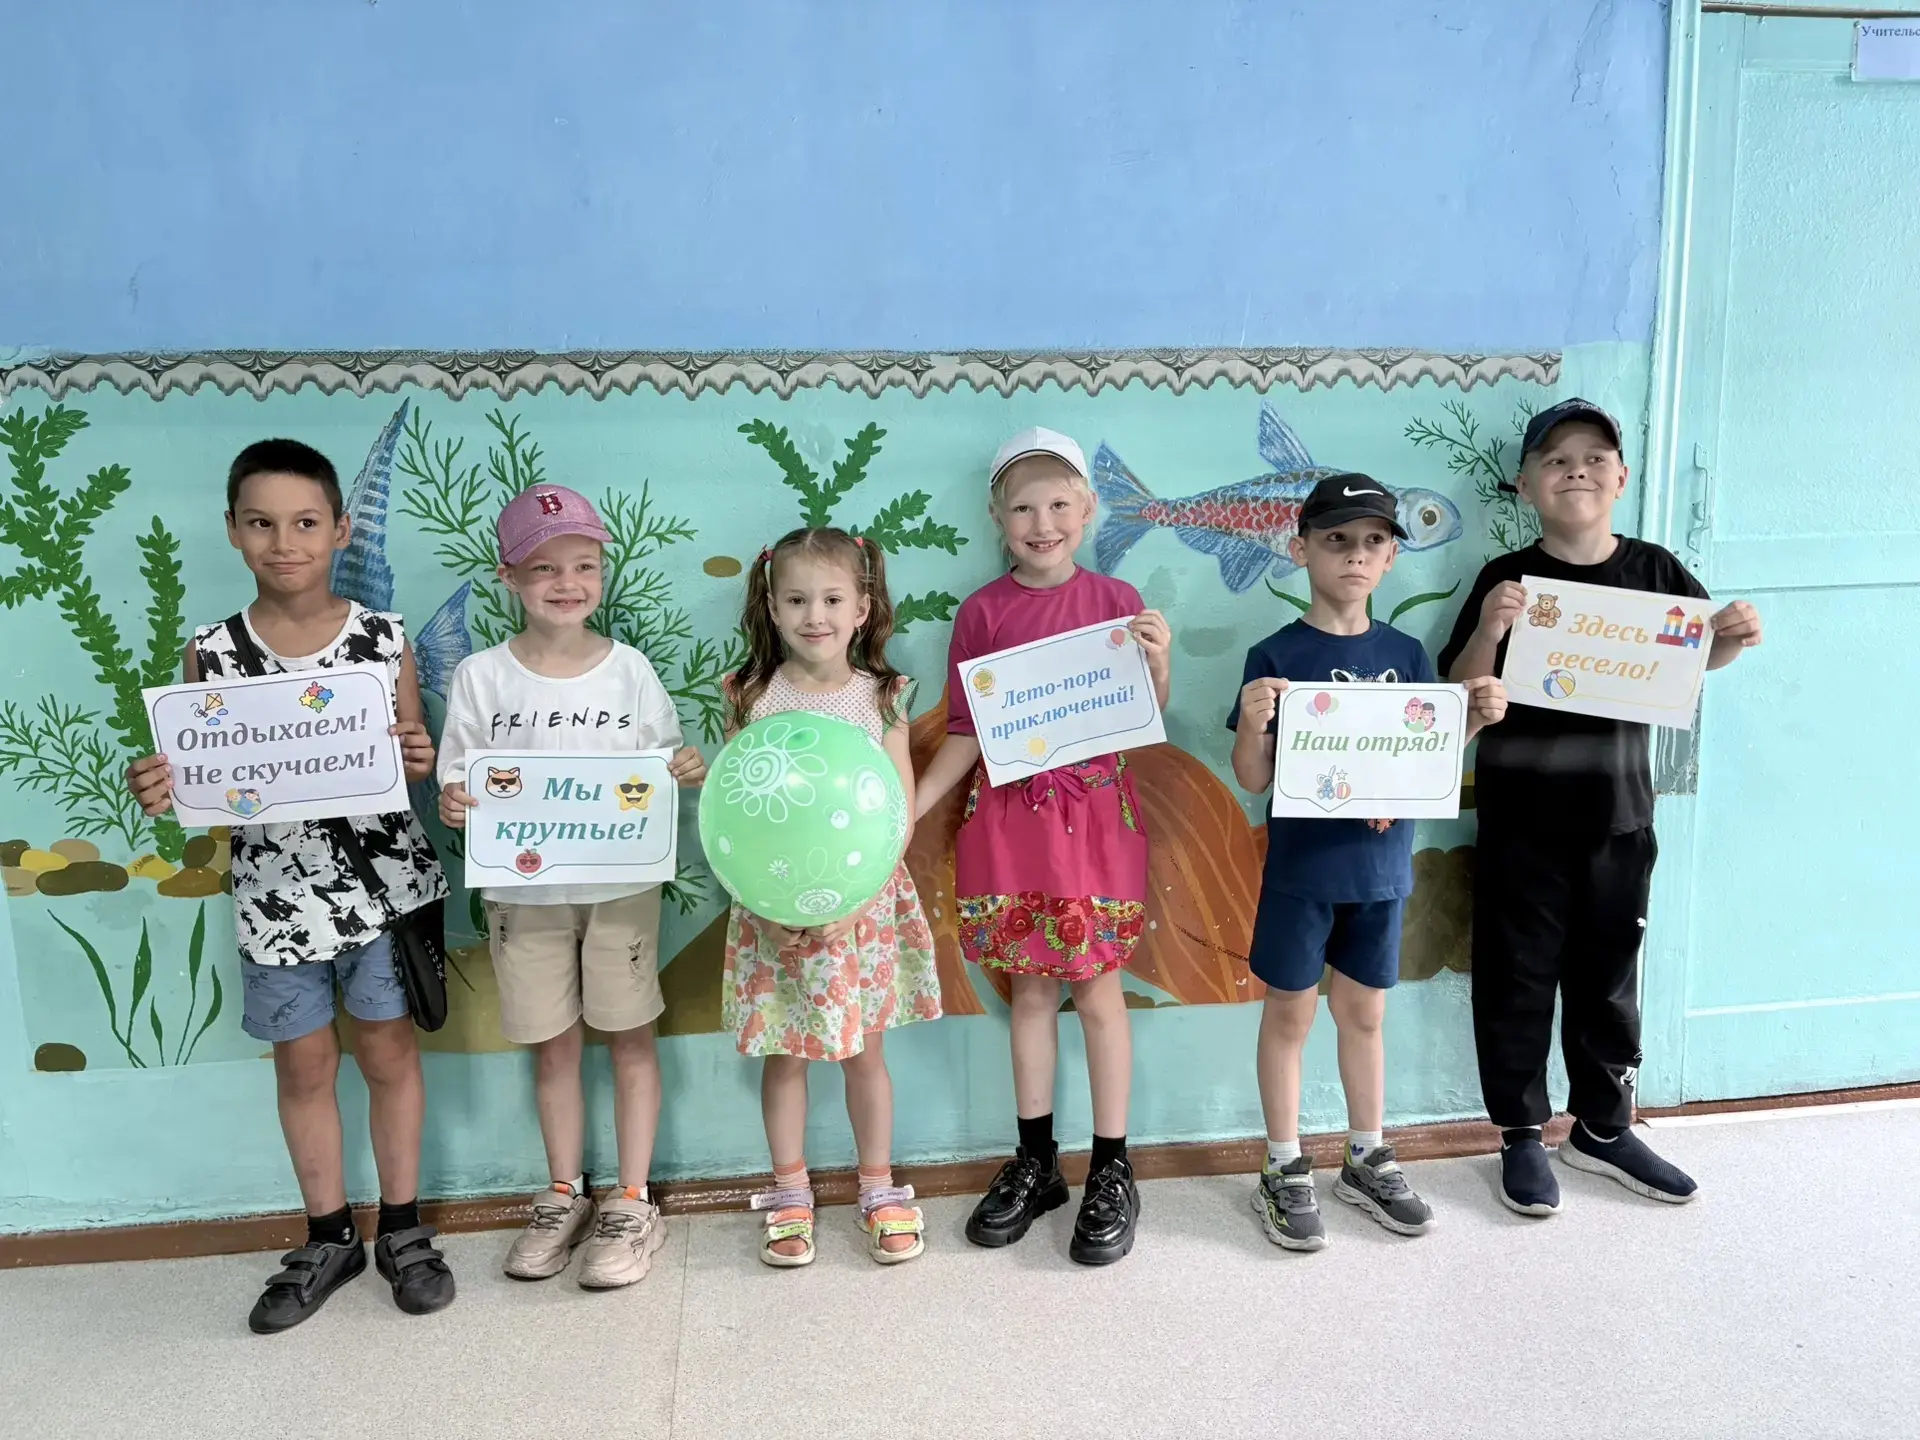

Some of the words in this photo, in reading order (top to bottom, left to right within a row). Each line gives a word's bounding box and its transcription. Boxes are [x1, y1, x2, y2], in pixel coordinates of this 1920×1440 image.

[1567, 612, 1649, 644] Здесь
[1547, 651, 1660, 681] весело!
[1001, 666, 1111, 709] Лето-пора
[990, 685, 1135, 739] приключений!
[177, 708, 368, 751] Отдыхаем!
[1290, 730, 1348, 751] Наш
[1356, 731, 1450, 757] отряд!
[183, 764, 222, 786] Не
[232, 745, 376, 785] скучаем!
[542, 777, 602, 801] Мы
[495, 817, 649, 846] крутые!
